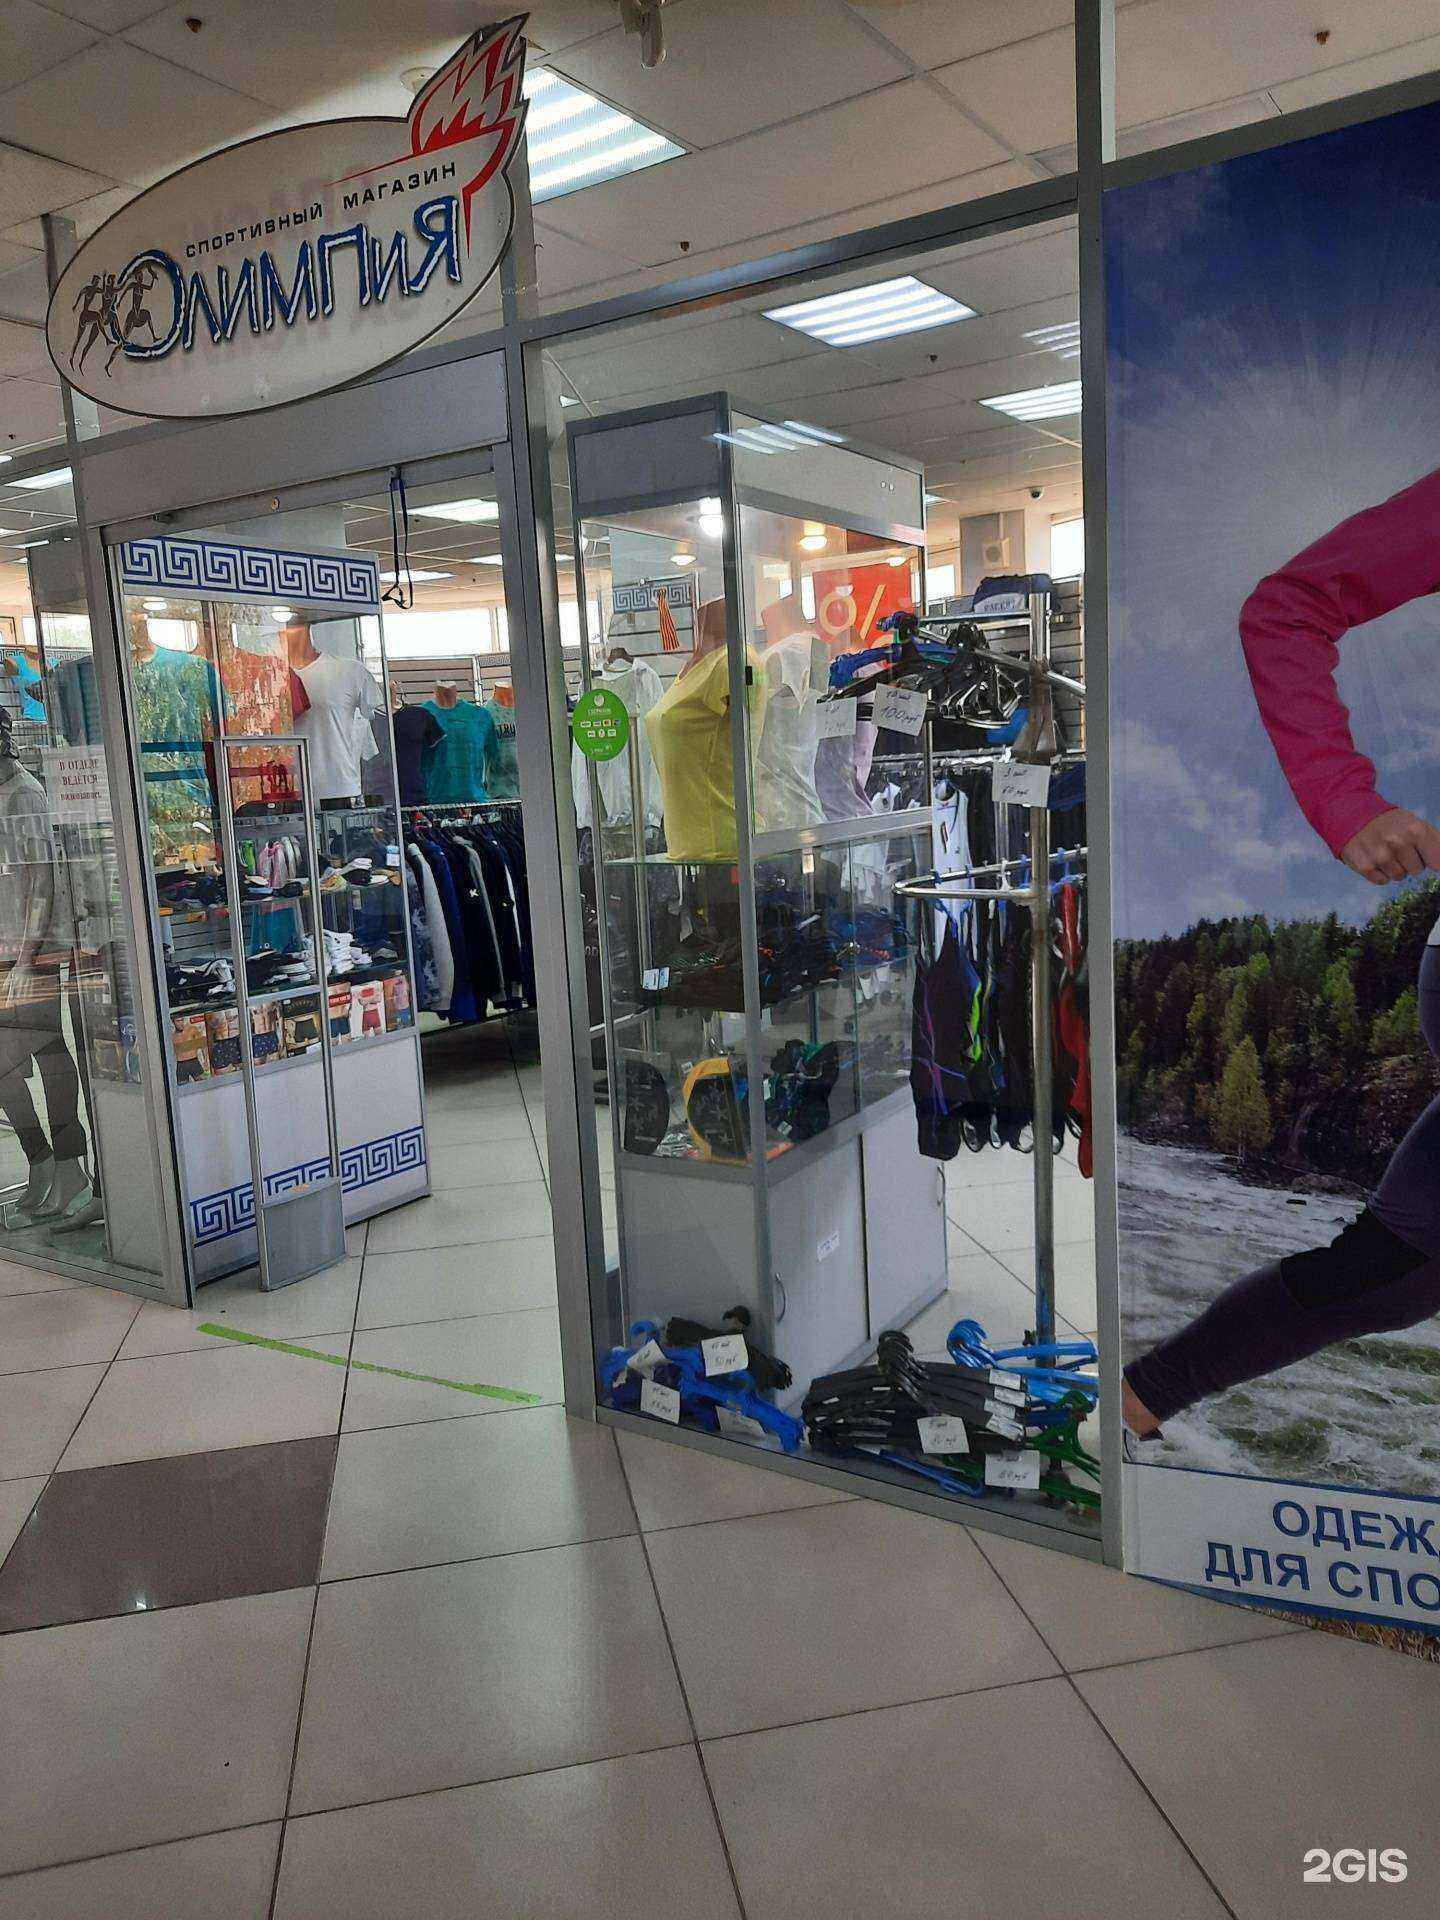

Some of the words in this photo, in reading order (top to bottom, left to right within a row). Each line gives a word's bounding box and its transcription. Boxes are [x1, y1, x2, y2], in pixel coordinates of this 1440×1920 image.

[185, 203, 323, 259] СПОРТИВНЫЙ
[342, 162, 456, 210] МАГАЗИН
[1272, 1500, 1440, 1563] ОДЕЖ
[1205, 1541, 1310, 1591] ДЛЯ
